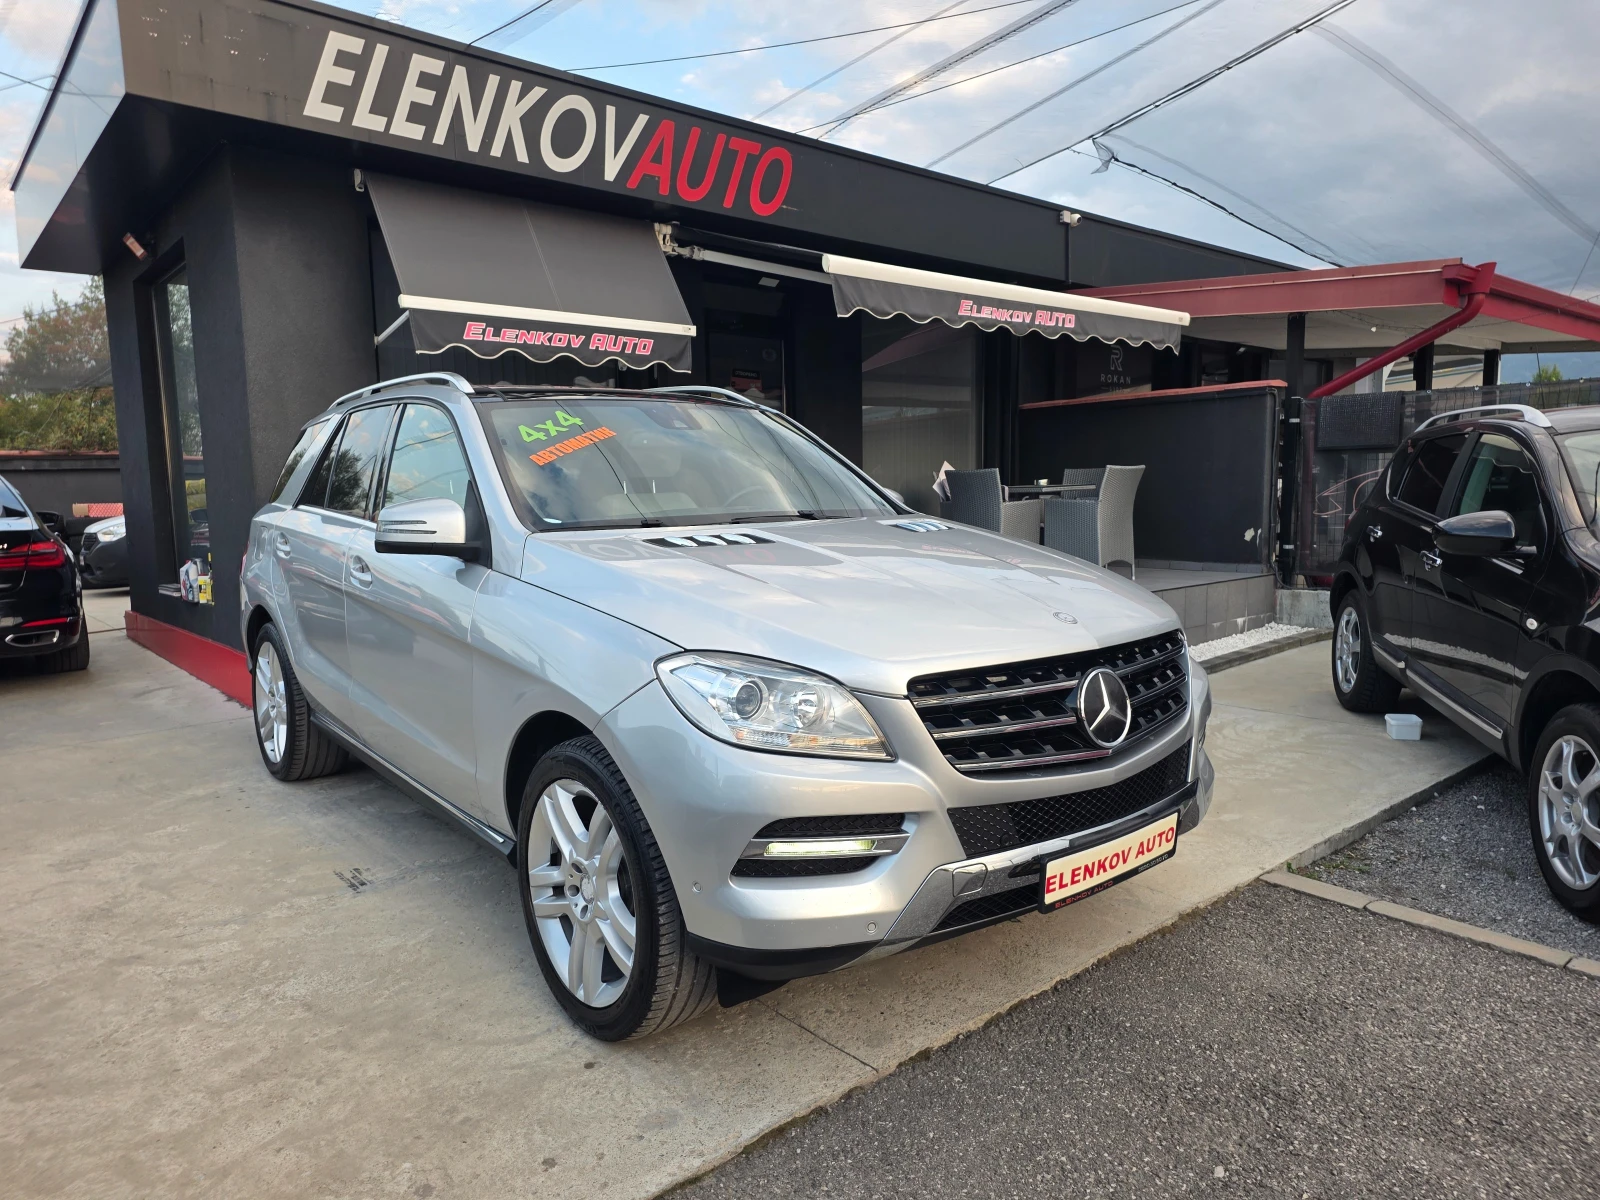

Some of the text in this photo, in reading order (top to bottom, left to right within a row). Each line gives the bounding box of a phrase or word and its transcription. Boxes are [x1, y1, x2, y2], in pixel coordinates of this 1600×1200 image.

[958, 300, 1075, 328] ELENKOV AUTO
[463, 321, 654, 355] ELENKOV AUTO
[1100, 373, 1131, 385] ROKAN
[1045, 847, 1132, 894] ELENKOV
[1135, 827, 1175, 859] AUTO
[1093, 880, 1114, 893] AUTO
